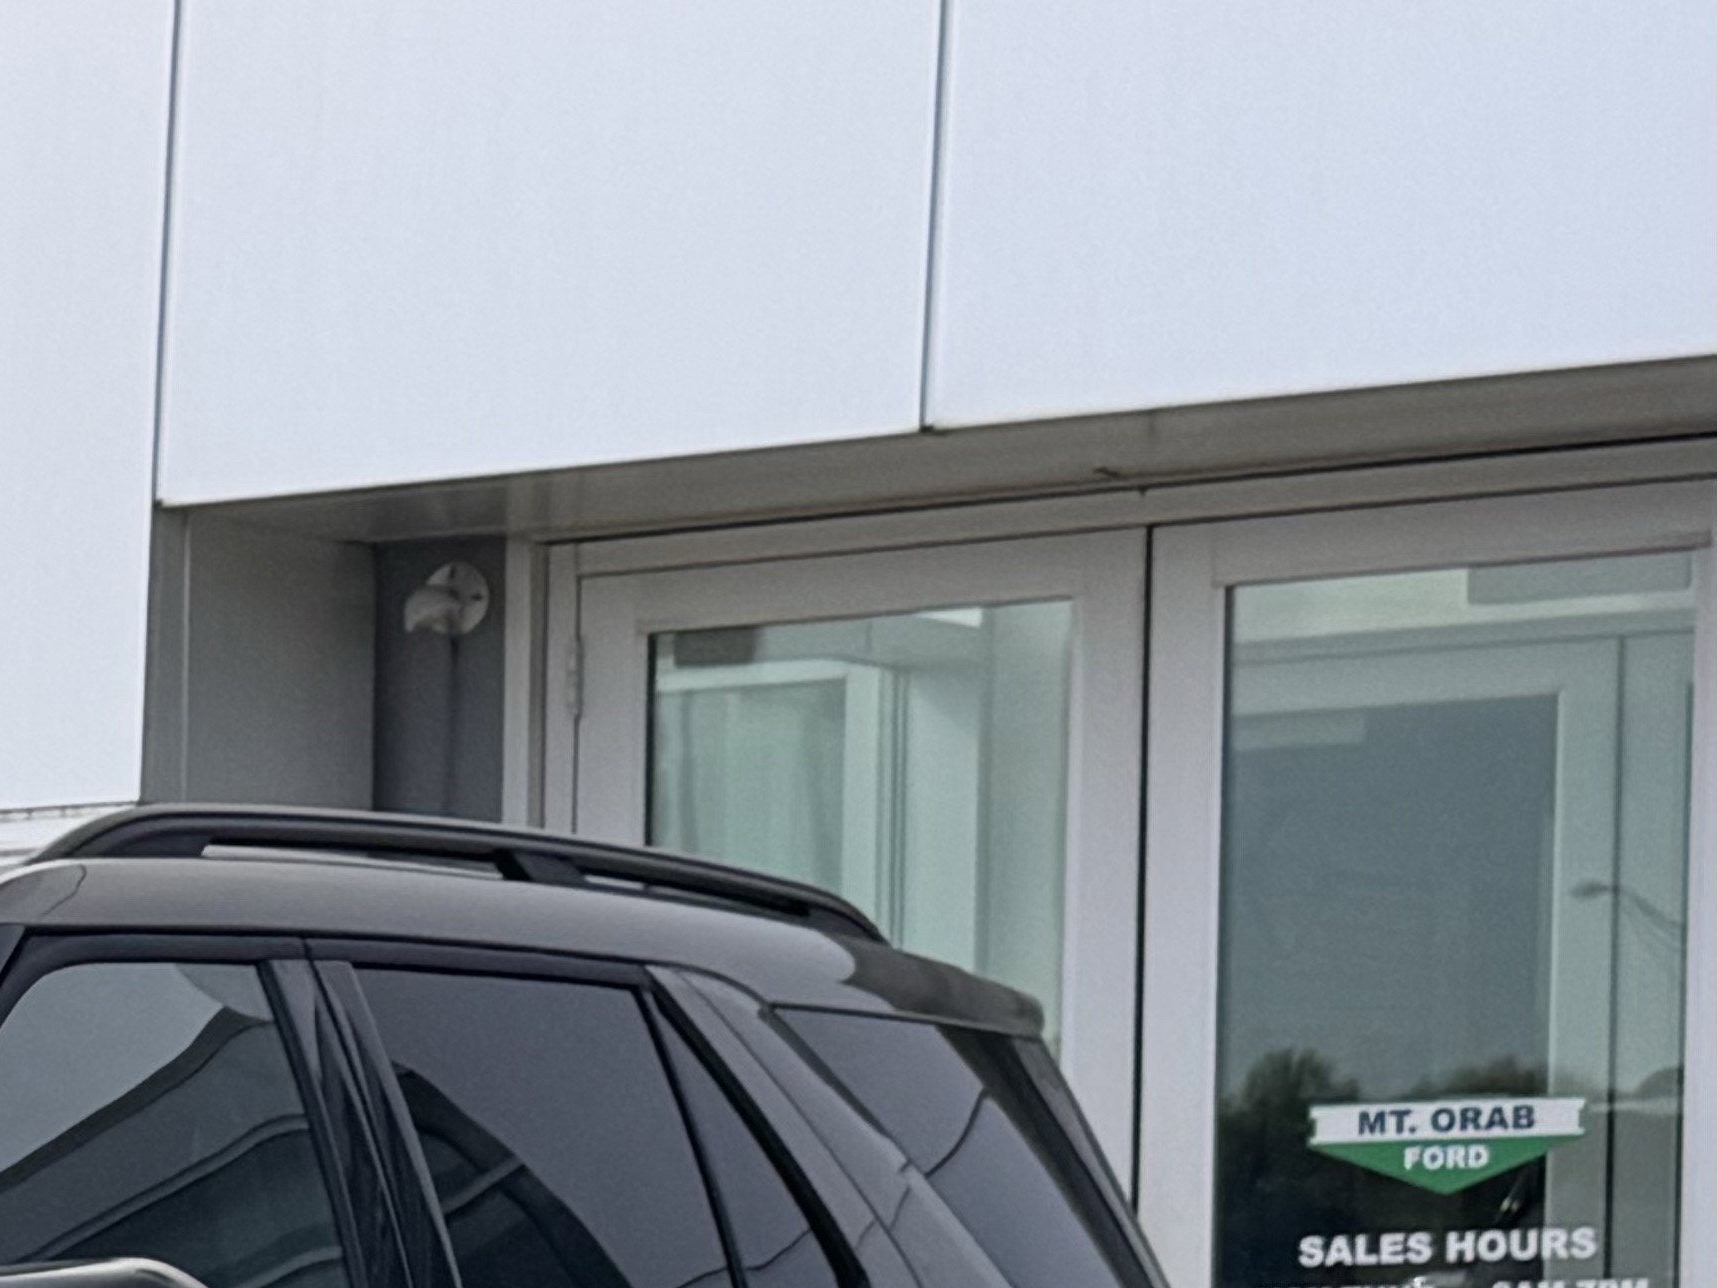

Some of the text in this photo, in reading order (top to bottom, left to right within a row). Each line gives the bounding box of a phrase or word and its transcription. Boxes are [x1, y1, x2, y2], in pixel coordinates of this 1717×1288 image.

[1358, 1105, 1536, 1136] MT. ORAB
[1404, 1145, 1490, 1170] FORD
[1298, 1227, 1597, 1267] SALES HOURS
